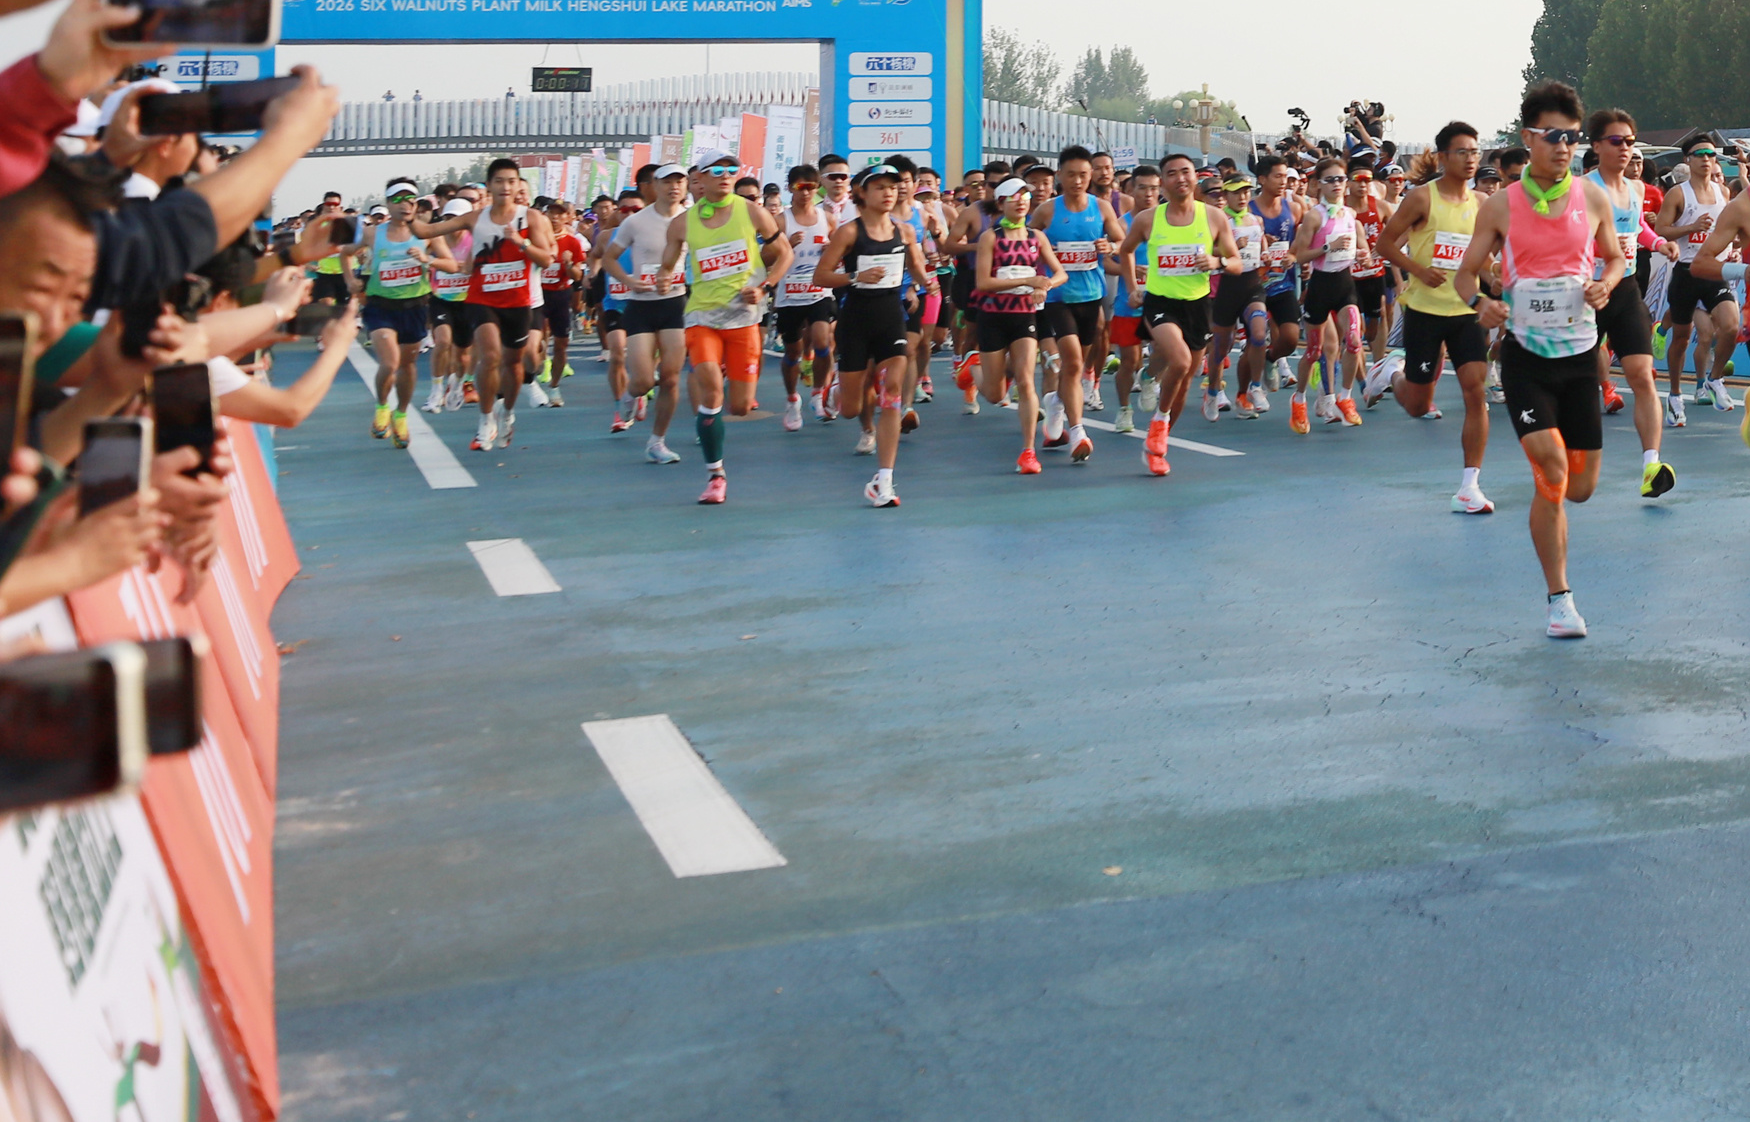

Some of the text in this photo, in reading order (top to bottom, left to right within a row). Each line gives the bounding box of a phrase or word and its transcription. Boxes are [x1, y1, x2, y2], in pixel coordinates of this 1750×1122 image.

[316, 0, 776, 12] 2026 SIX WALNUTS PLANT MILK HENGSHUI LAKE MARATHON
[866, 57, 916, 71] 六个核桃
[1436, 245, 1466, 257] A197
[701, 251, 746, 270] A12424
[1161, 256, 1196, 266] A1203
